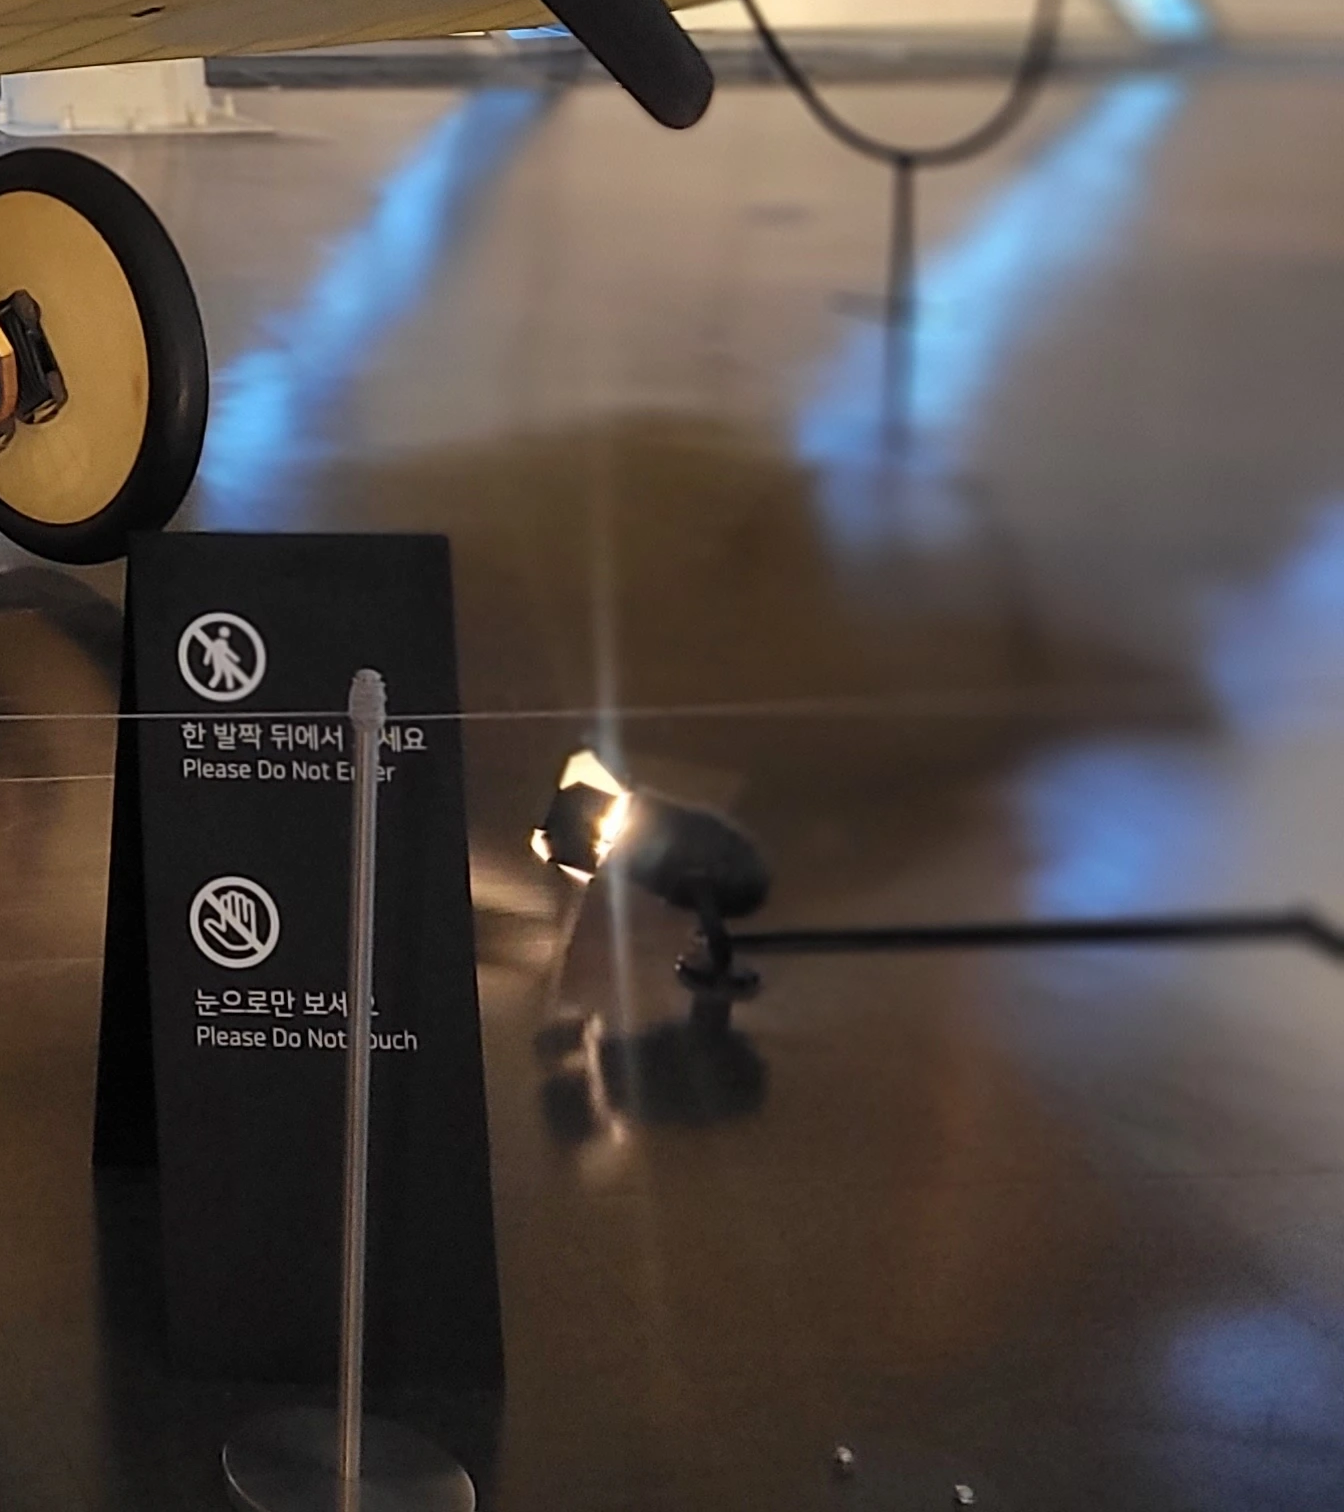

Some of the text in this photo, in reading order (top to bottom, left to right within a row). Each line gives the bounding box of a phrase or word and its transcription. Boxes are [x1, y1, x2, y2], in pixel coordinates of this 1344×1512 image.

[180, 721, 428, 752] 한 발짝 뒤에서 세요
[182, 757, 397, 782] Please Do Not Eer
[195, 988, 296, 1017] 눈으로만
[196, 1025, 418, 1050] Please Do Not ouch
